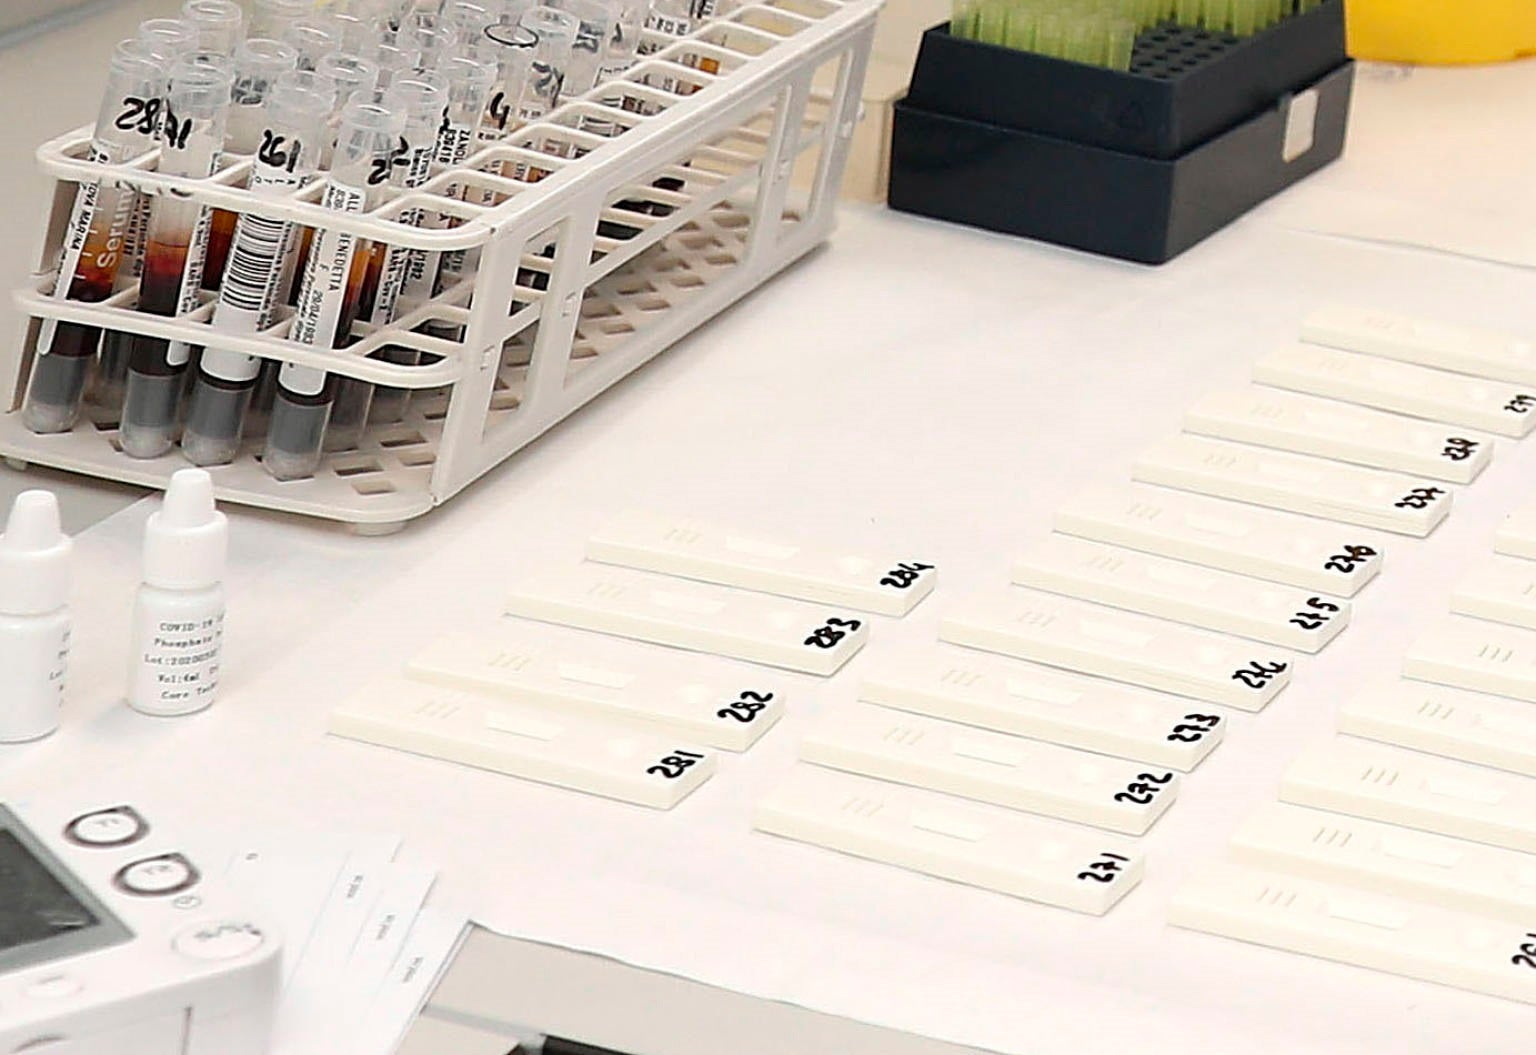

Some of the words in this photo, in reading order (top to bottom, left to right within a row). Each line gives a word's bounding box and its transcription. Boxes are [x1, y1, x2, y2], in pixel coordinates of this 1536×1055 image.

[96, 186, 134, 270] Serum
[878, 561, 936, 590] 284
[802, 616, 863, 650] 283
[715, 689, 775, 724] 282
[645, 749, 706, 780] 281
